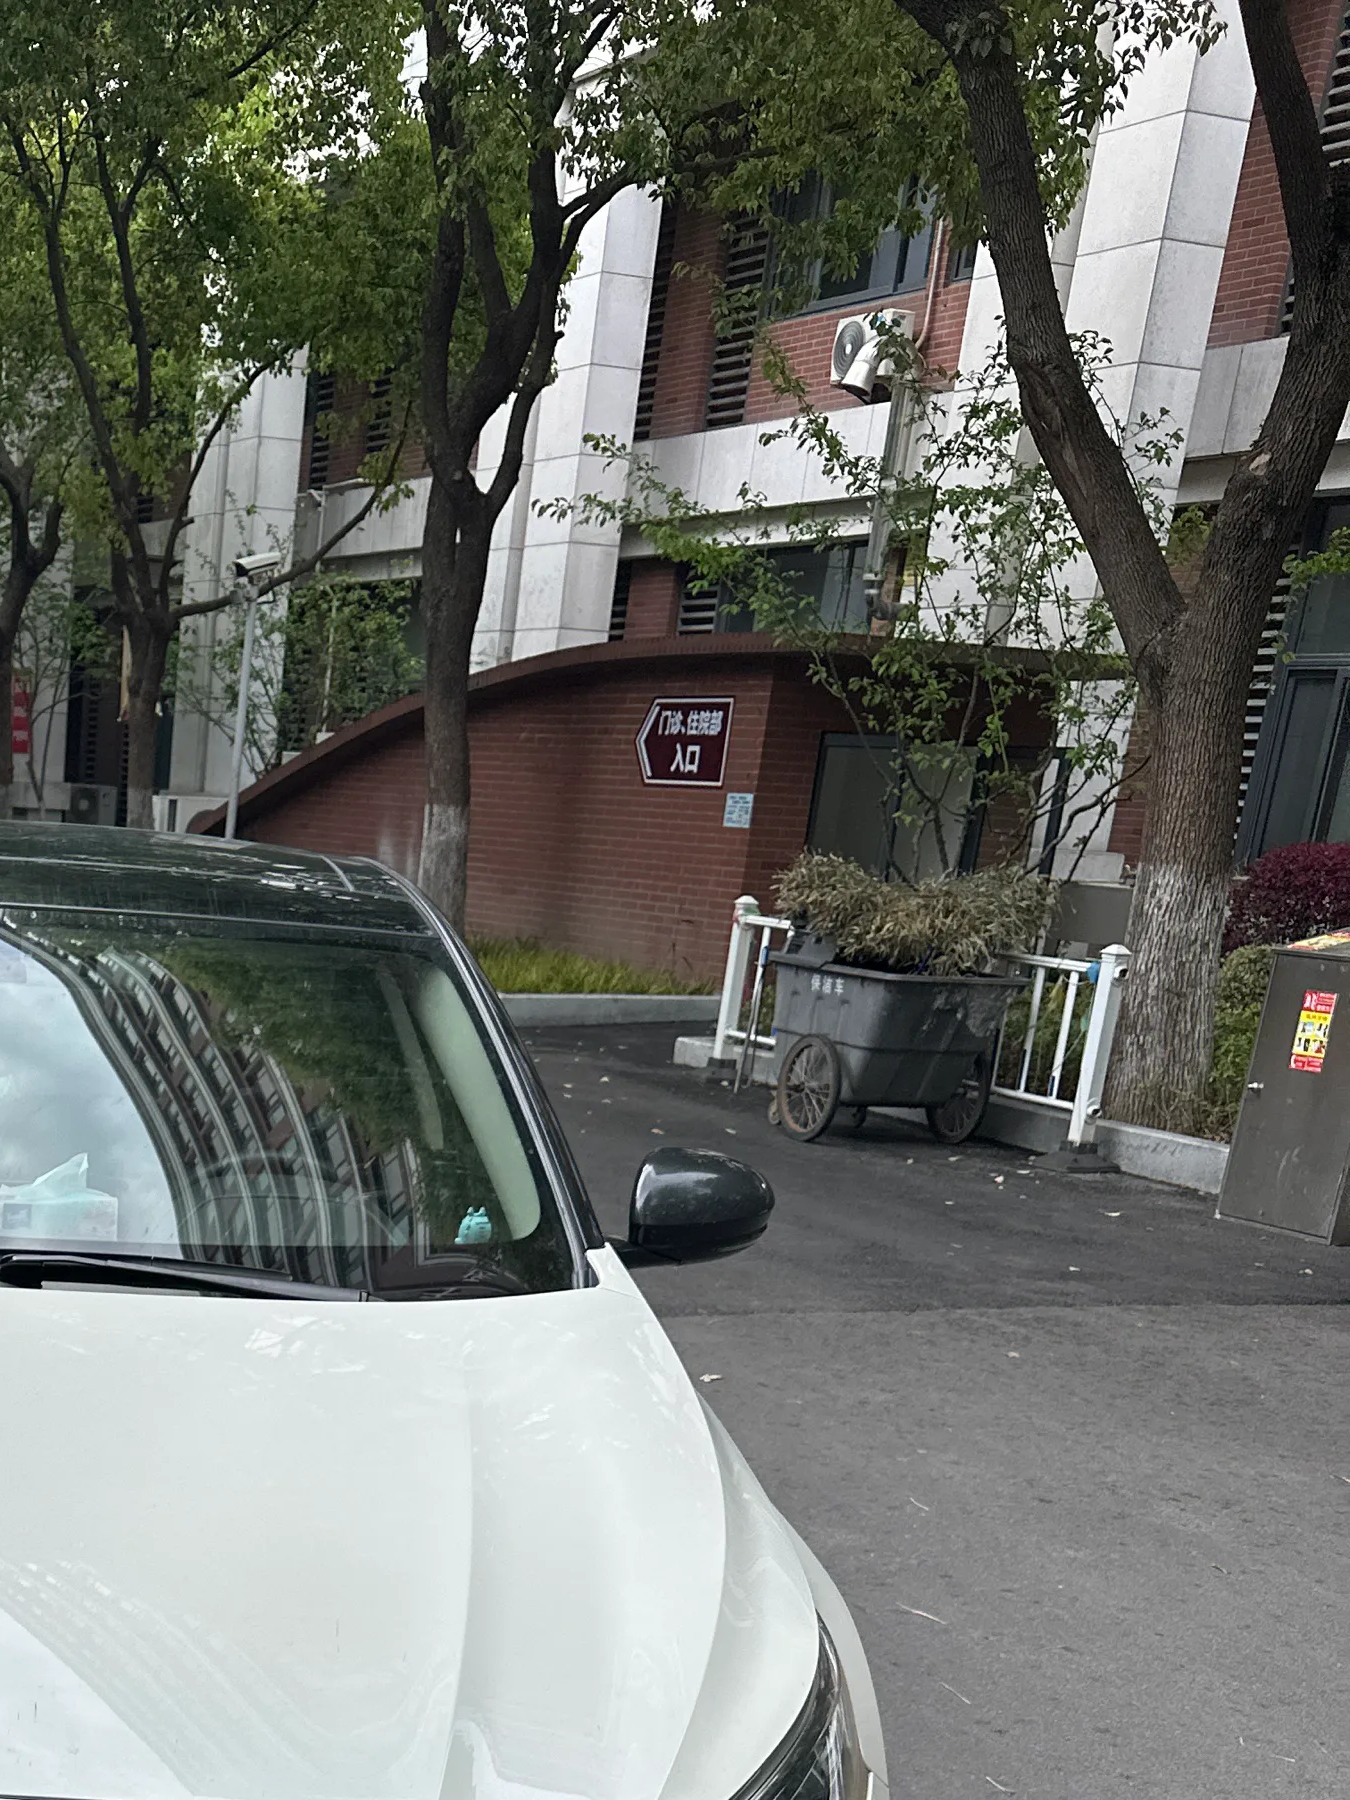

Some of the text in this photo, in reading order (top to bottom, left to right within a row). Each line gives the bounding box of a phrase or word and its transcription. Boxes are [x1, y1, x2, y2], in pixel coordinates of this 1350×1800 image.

[658, 710, 724, 736] 门诊、住院部
[670, 742, 700, 773] 入口
[811, 973, 845, 997] 保洁车
